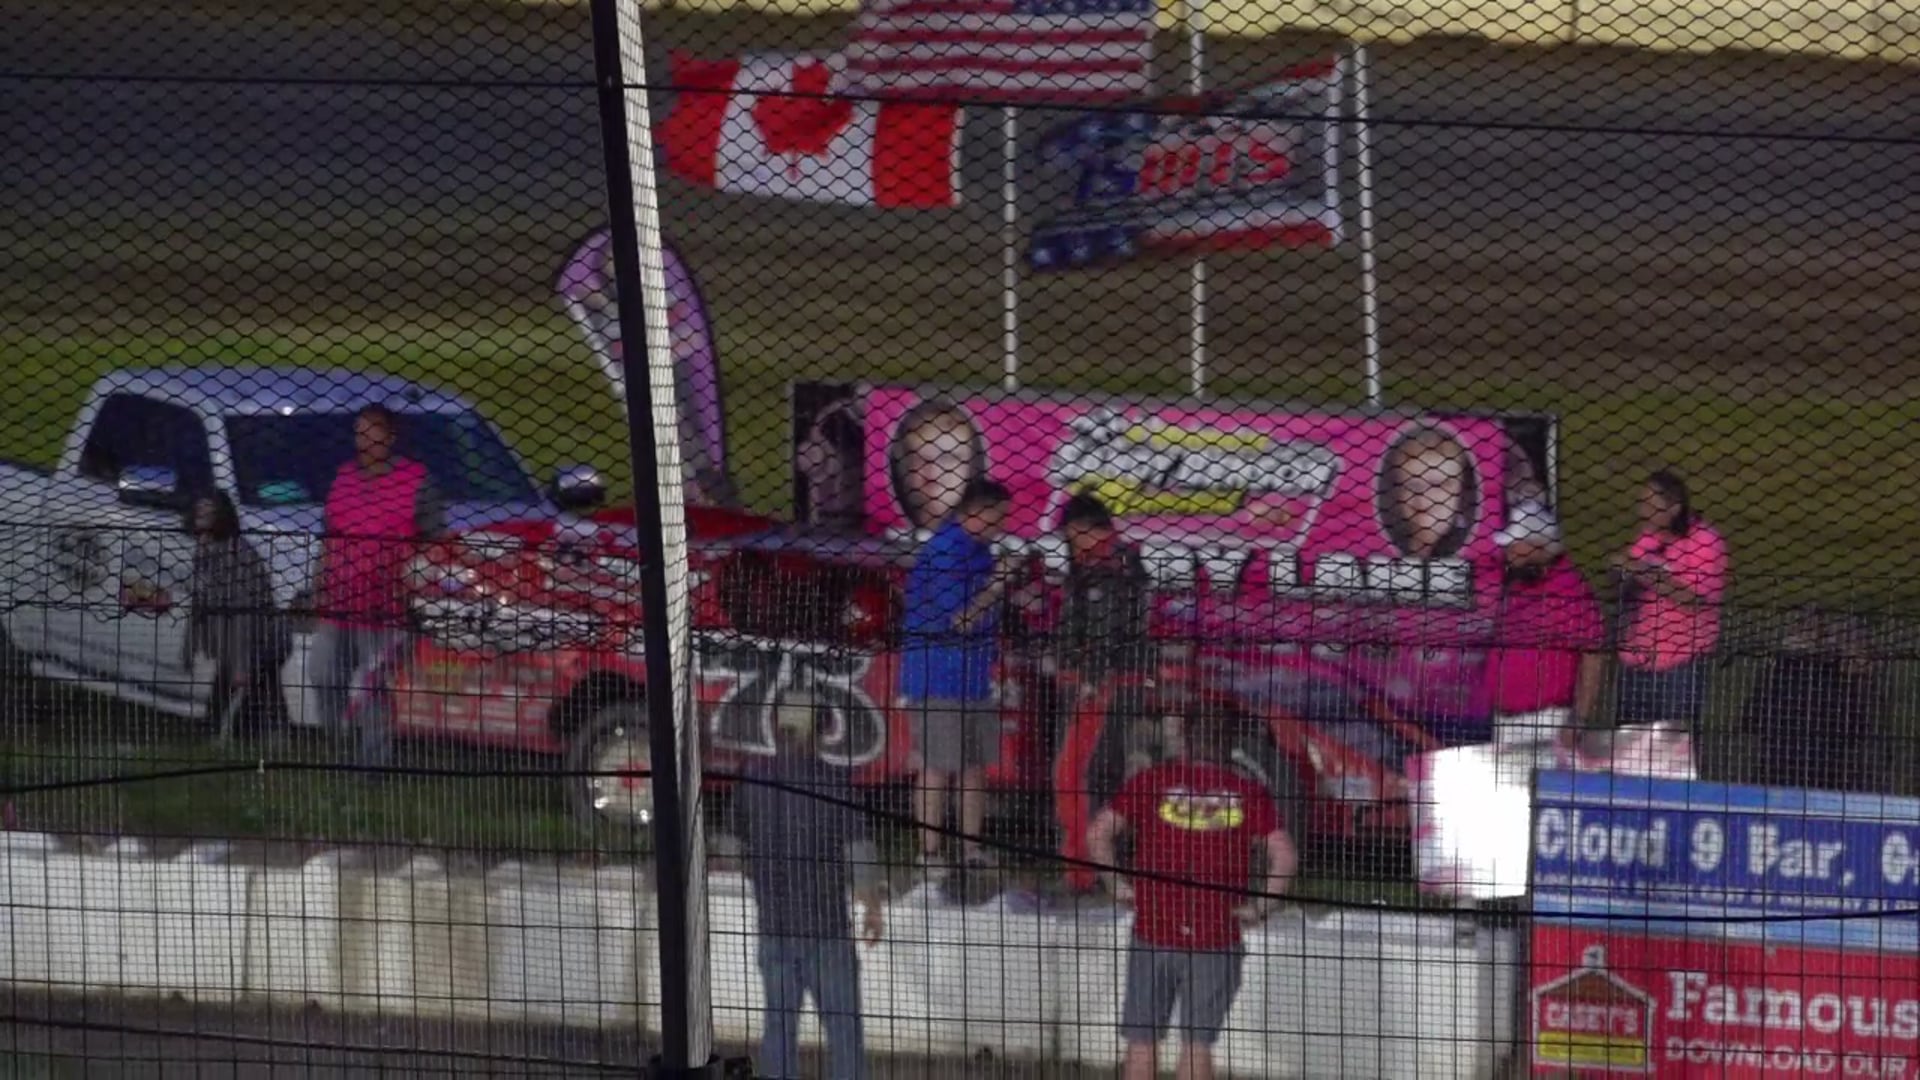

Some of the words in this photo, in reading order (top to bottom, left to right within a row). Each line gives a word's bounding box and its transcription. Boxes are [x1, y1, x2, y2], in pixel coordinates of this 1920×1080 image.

[1268, 549, 1472, 608] LANE
[1537, 807, 1668, 868] Cloud
[1691, 816, 1725, 872] 9
[1747, 821, 1855, 887] Bar,
[1881, 830, 1920, 887] G
[1665, 971, 1920, 1040] Famous
[1665, 1035, 1836, 1074] DOWNLOAD
[1844, 1050, 1908, 1079] OUR
